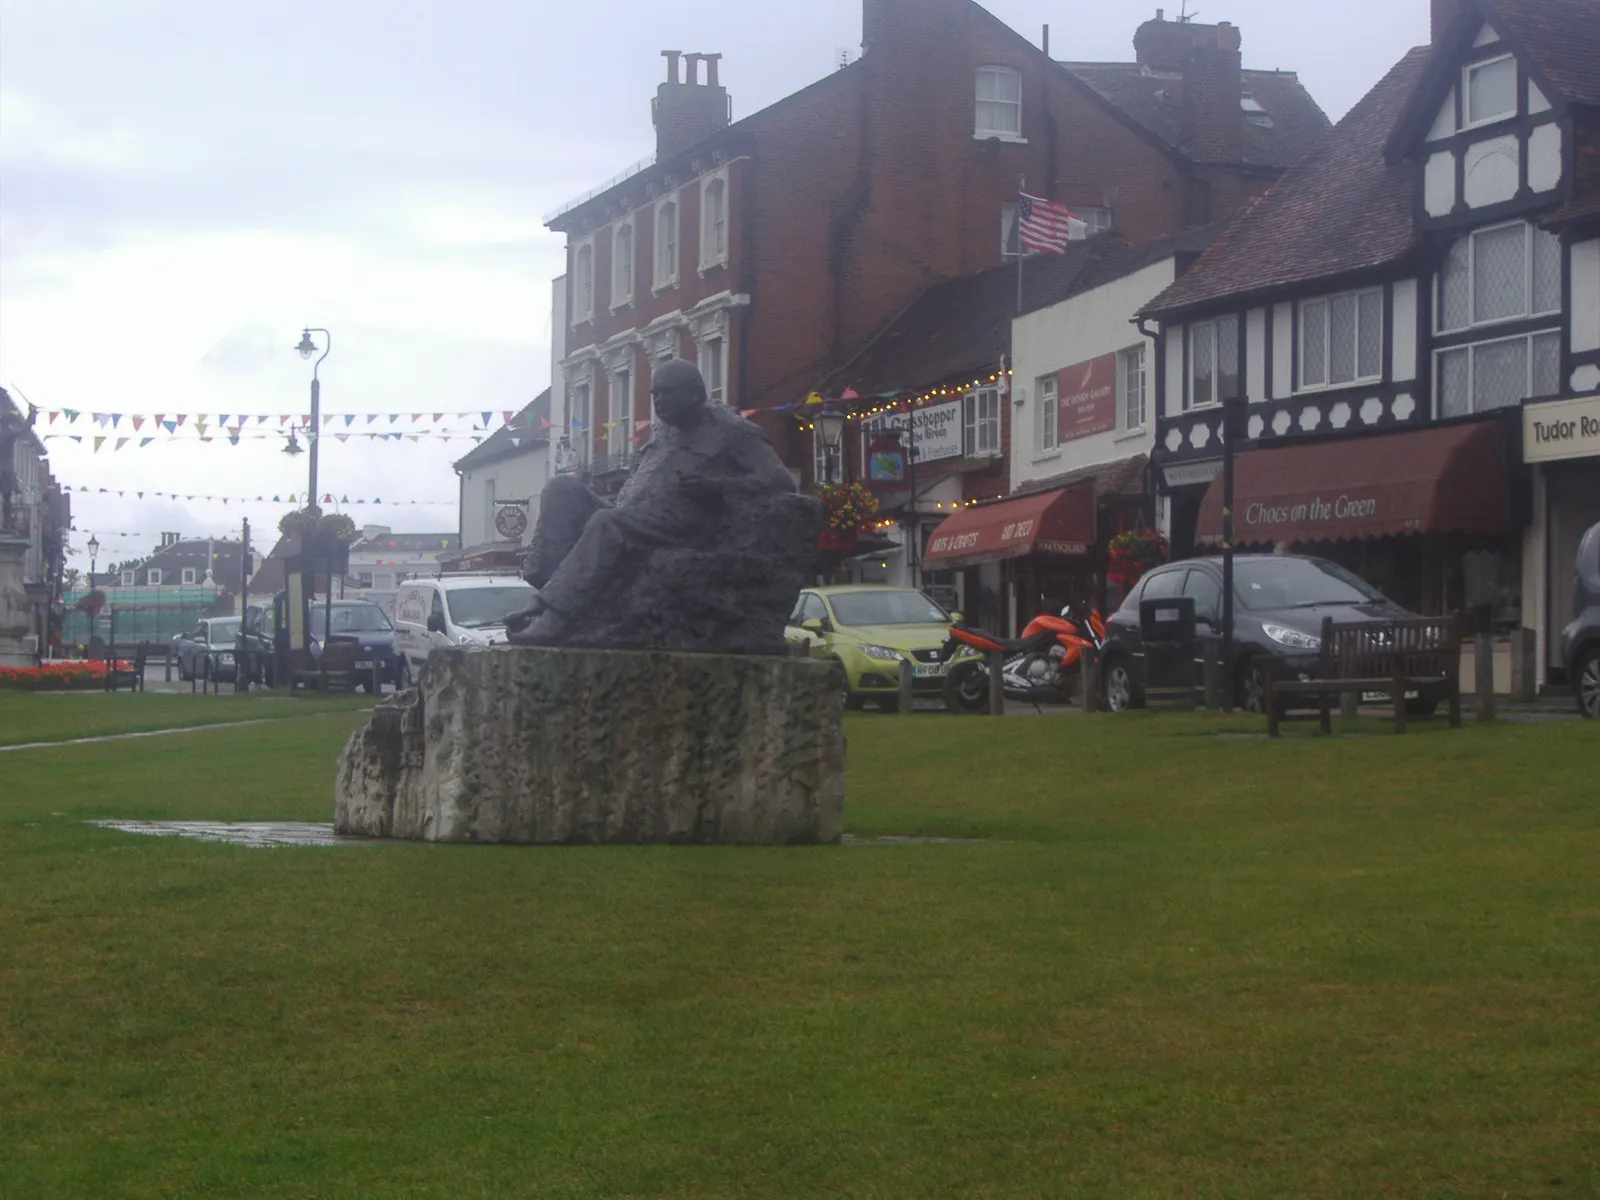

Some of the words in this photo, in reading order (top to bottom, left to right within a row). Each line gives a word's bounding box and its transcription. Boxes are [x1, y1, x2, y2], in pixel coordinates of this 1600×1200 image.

[1533, 419, 1576, 444] Tudor
[1581, 416, 1600, 438] Ro
[1246, 502, 1288, 524] Chocs
[1291, 504, 1307, 521] on
[1310, 496, 1332, 520] the
[1335, 494, 1376, 518] Green
[1002, 525, 1014, 541] ART
[1014, 520, 1034, 538] DECO
[931, 537, 947, 553] ARTS
[954, 532, 980, 550] CRAFTS
[1038, 541, 1085, 554] ANTIQUES
